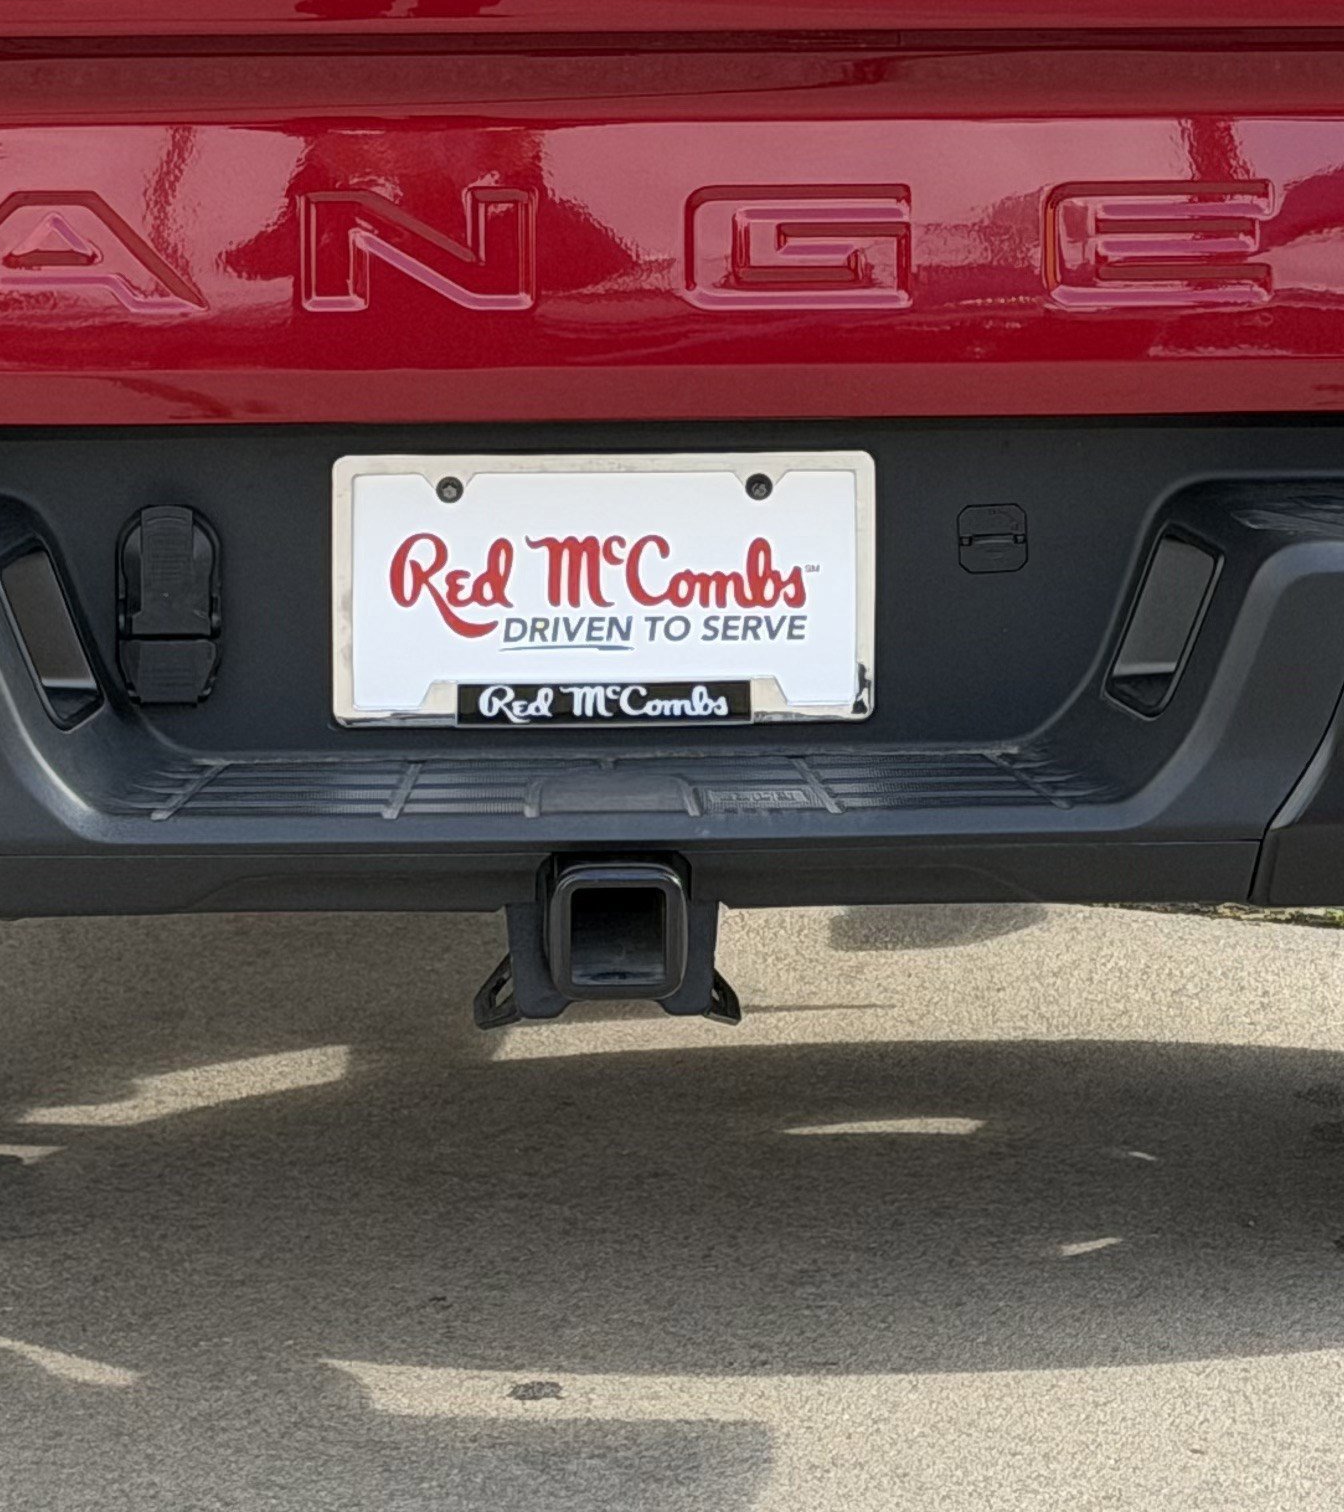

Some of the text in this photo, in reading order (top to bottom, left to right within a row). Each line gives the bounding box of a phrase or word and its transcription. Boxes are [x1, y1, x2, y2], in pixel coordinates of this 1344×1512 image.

[389, 533, 514, 638] Red
[526, 534, 806, 609] McCombs
[502, 616, 808, 642] DRIVEN TO SERVE
[479, 686, 728, 723] Red McCombs
